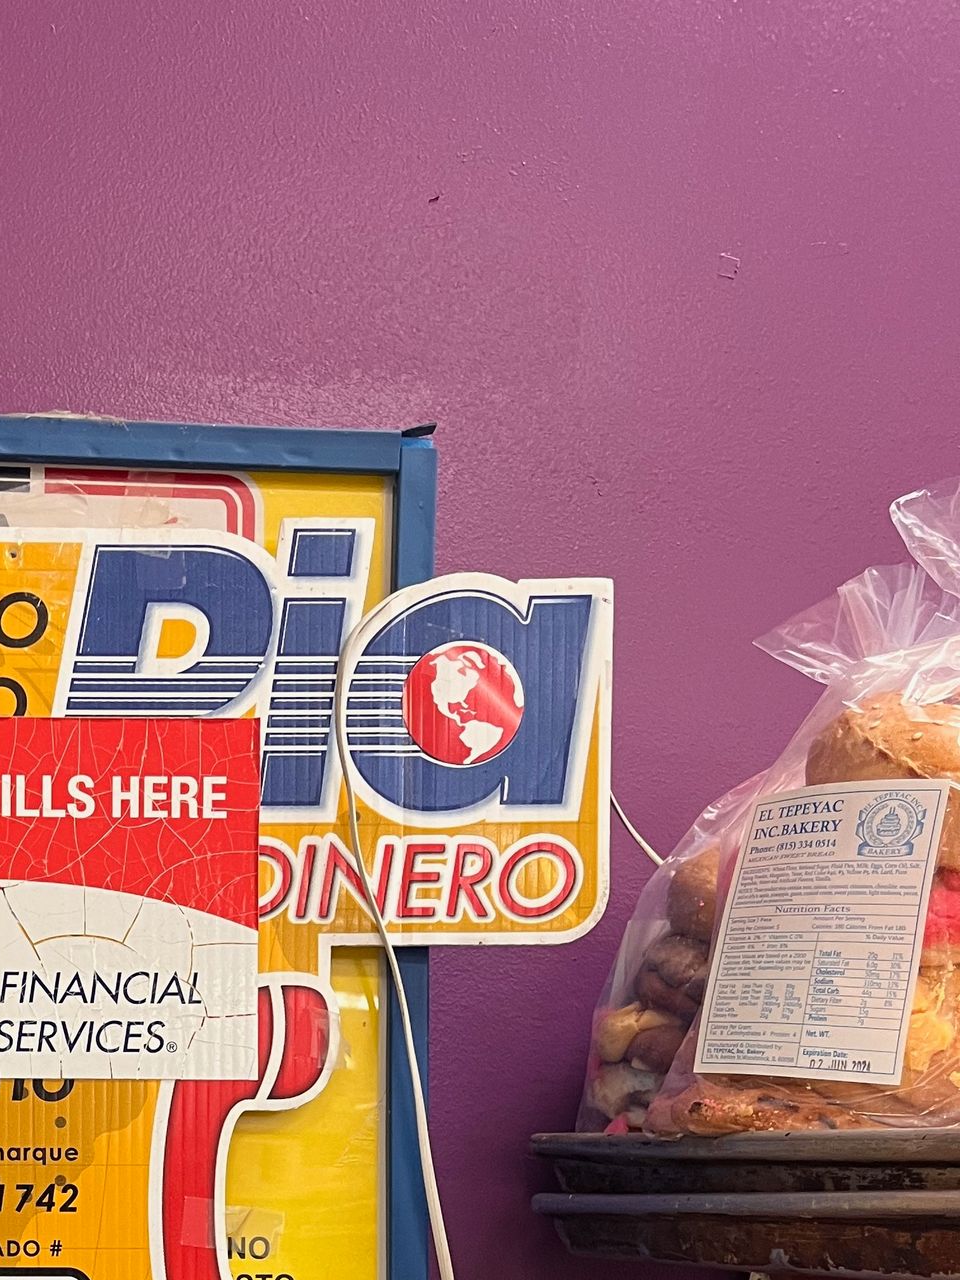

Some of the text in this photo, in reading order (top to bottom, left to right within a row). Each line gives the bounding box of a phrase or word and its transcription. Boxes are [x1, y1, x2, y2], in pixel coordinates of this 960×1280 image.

[66, 528, 593, 812] Ria
[110, 774, 228, 820] HERE
[758, 799, 845, 822] EL TEPEYAC
[797, 840, 813, 850] 334
[774, 904, 851, 914] Nutrition Facts
[0, 971, 202, 1005] FINANCIAL
[802, 1048, 832, 1058] Expiration
[49, 1239, 63, 1257] #
